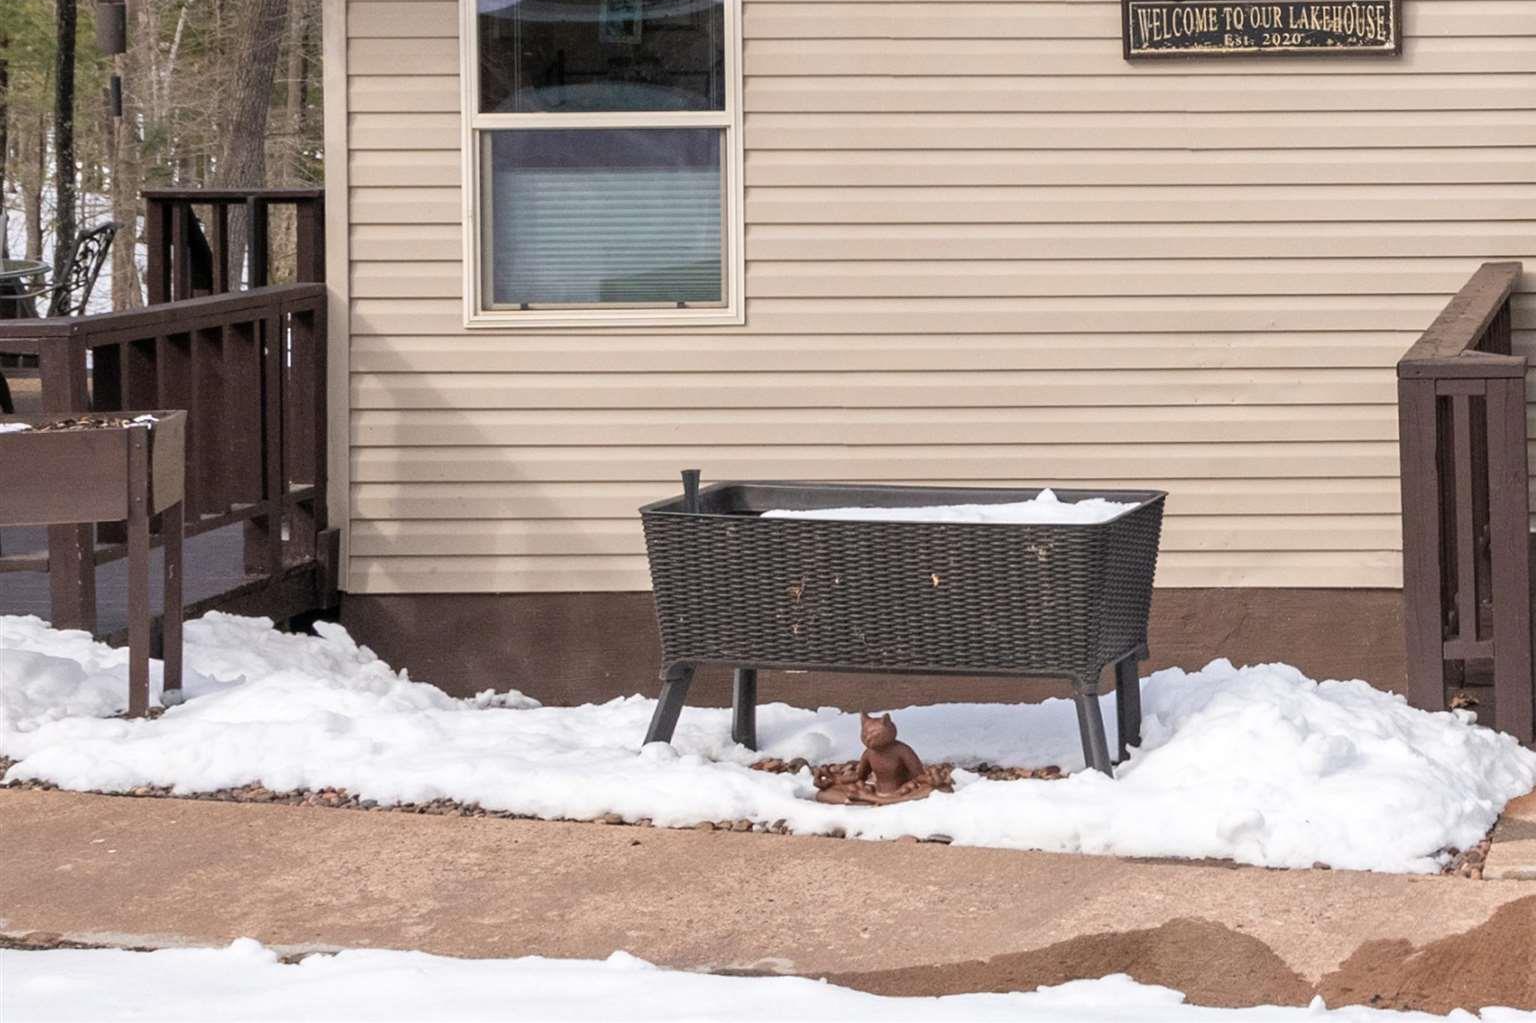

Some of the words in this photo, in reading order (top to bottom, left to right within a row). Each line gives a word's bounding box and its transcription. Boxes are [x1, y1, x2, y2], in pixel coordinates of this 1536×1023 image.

[1137, 7, 1218, 44] WELCOME
[1223, 7, 1244, 30] TO
[1250, 6, 1283, 29] OUR
[1289, 5, 1386, 41] LAKEHOUSE
[1263, 33, 1301, 46] 2020
